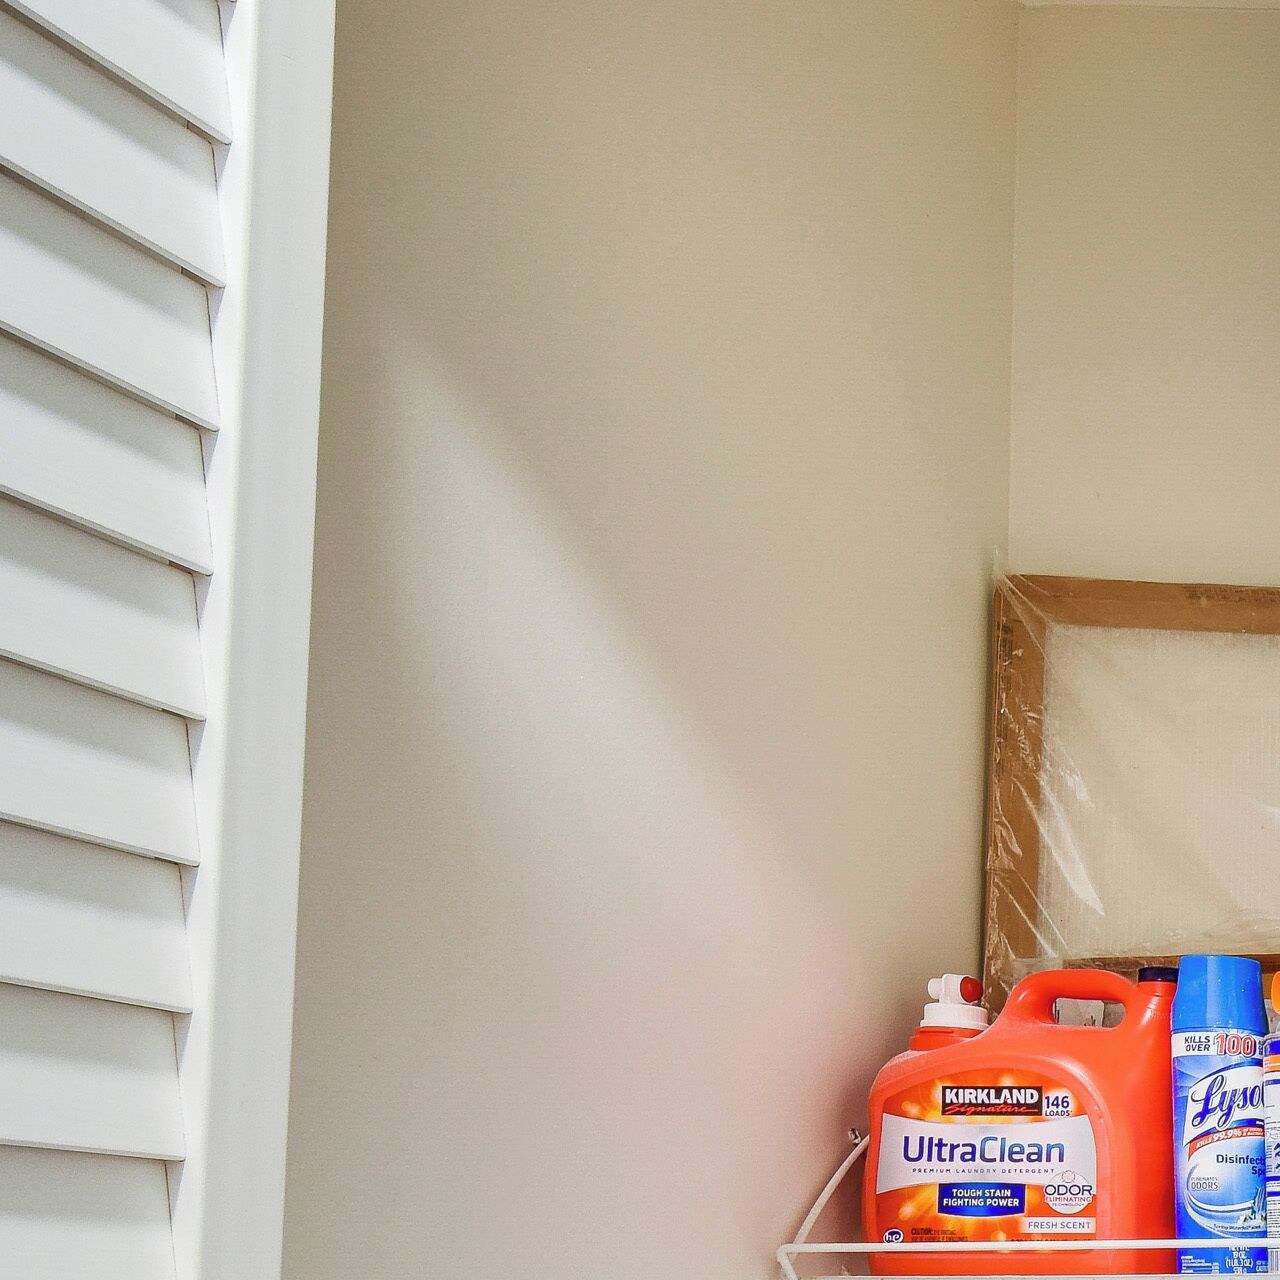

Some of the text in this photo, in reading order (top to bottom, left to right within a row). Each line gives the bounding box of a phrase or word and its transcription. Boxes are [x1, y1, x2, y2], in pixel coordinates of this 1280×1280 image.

[1184, 1036, 1210, 1044] KILLS
[1214, 1033, 1256, 1057] 100
[1185, 1044, 1210, 1052] OVER
[945, 1088, 1039, 1104] KIRKLAND
[1045, 1095, 1070, 1109] 146
[1190, 1074, 1264, 1127] Lyso
[944, 1104, 1039, 1116] Signature
[903, 1135, 1065, 1163] UltraClean
[1044, 1184, 1093, 1196] ODOR
[1191, 1182, 1218, 1190] ODORS
[952, 1188, 1011, 1197] TOUGH STAIN
[943, 1198, 1019, 1207] FIGHTING POWER
[1028, 1221, 1091, 1229] FRESH SCENT
